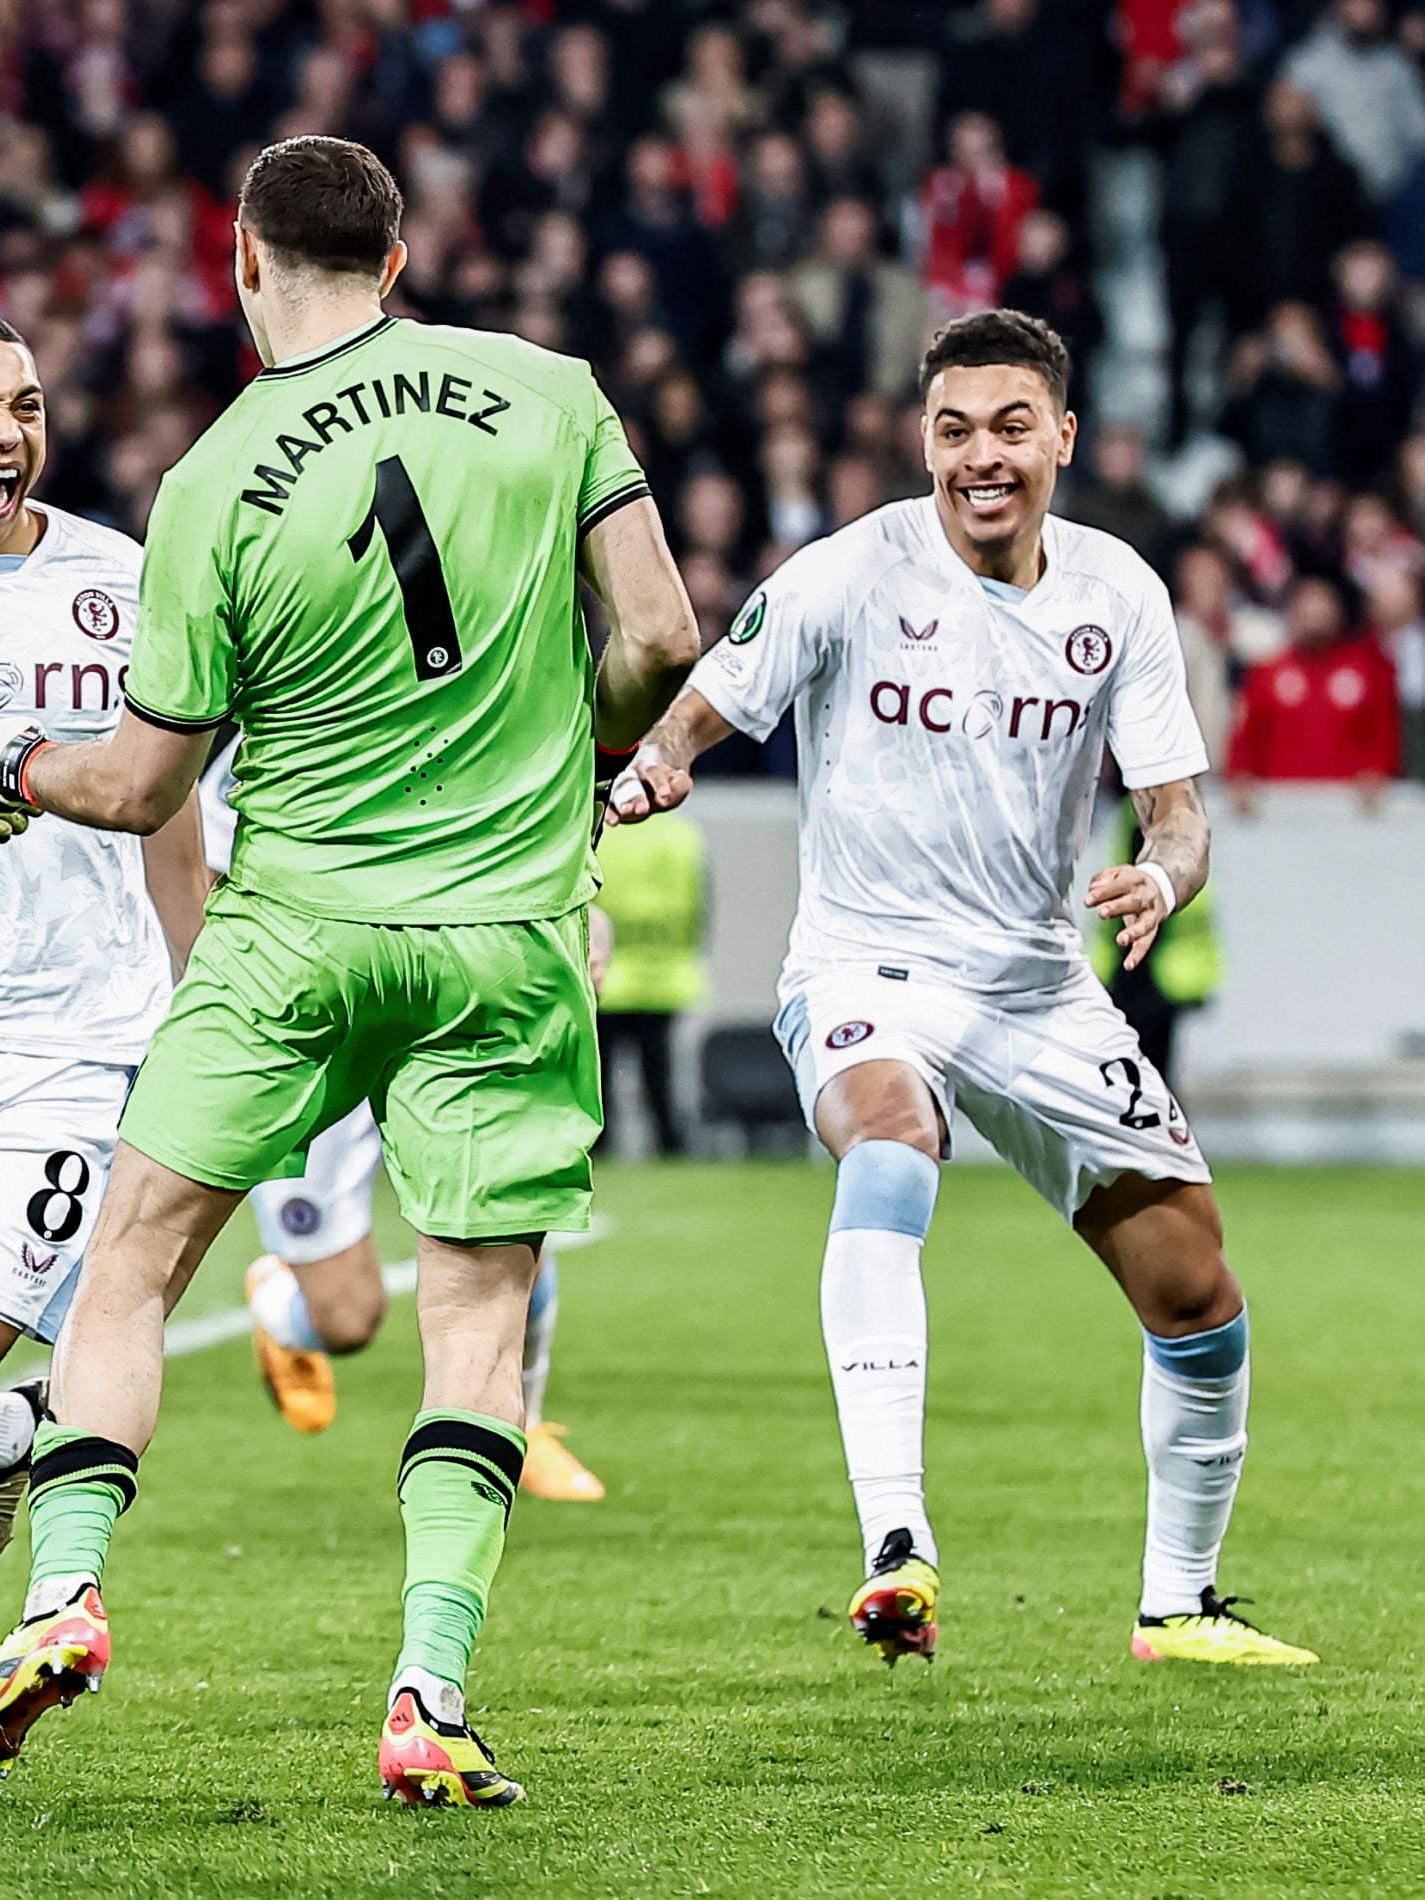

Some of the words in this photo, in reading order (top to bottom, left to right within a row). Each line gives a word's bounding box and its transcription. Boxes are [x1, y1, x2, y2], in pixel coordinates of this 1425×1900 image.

[240, 371, 512, 517] MARTINEZ
[346, 454, 463, 682] 1
[26, 1150, 90, 1243] 8
[841, 1359, 919, 1372] VILLA
